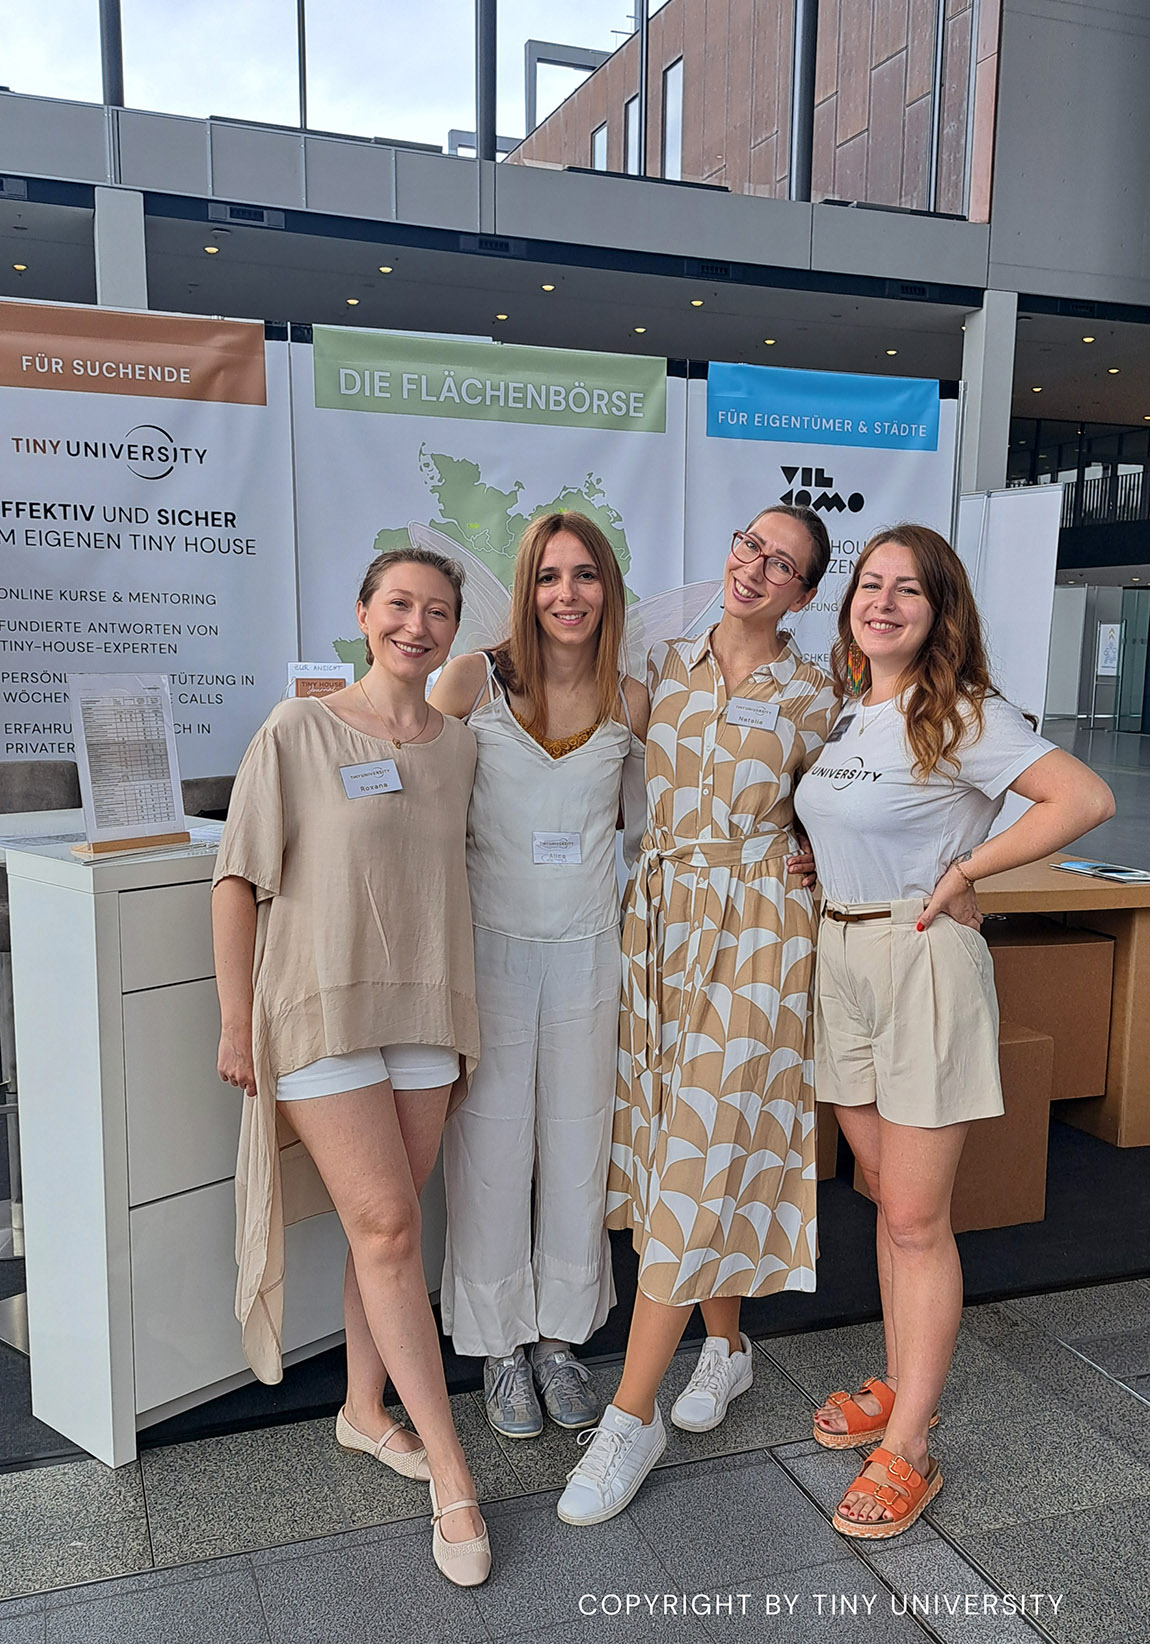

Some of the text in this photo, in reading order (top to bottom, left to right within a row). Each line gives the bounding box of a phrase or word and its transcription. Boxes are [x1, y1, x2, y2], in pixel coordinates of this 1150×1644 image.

[21, 353, 192, 384] FÜR SUCHENDE
[339, 367, 645, 418] DIE FLÄCHENBÖRSE
[718, 409, 927, 437] FÜR EIGENTÜMER & STÄDTE
[66, 440, 208, 465] UNIVERSITY
[1, 501, 238, 529] FFEKTIV UND SICHER
[25, 530, 121, 550] EIGENEN
[129, 534, 176, 552] TINY
[184, 537, 257, 556] HOUSE
[825, 559, 856, 574] ZEN
[0, 588, 217, 605] ONLINE KURSE & MENTORING
[0, 620, 219, 636] FUNDIERTE ANTWORTEN VON
[169, 672, 236, 686] TÜTZUNG
[241, 675, 255, 686] IN
[178, 693, 224, 704] CALLS
[4, 723, 72, 734] ERFAHRU
[197, 723, 211, 734] IN
[6, 742, 76, 754] PRIVATER
[811, 766, 882, 782] UNIVERSITY
[360, 782, 389, 793] Roxana
